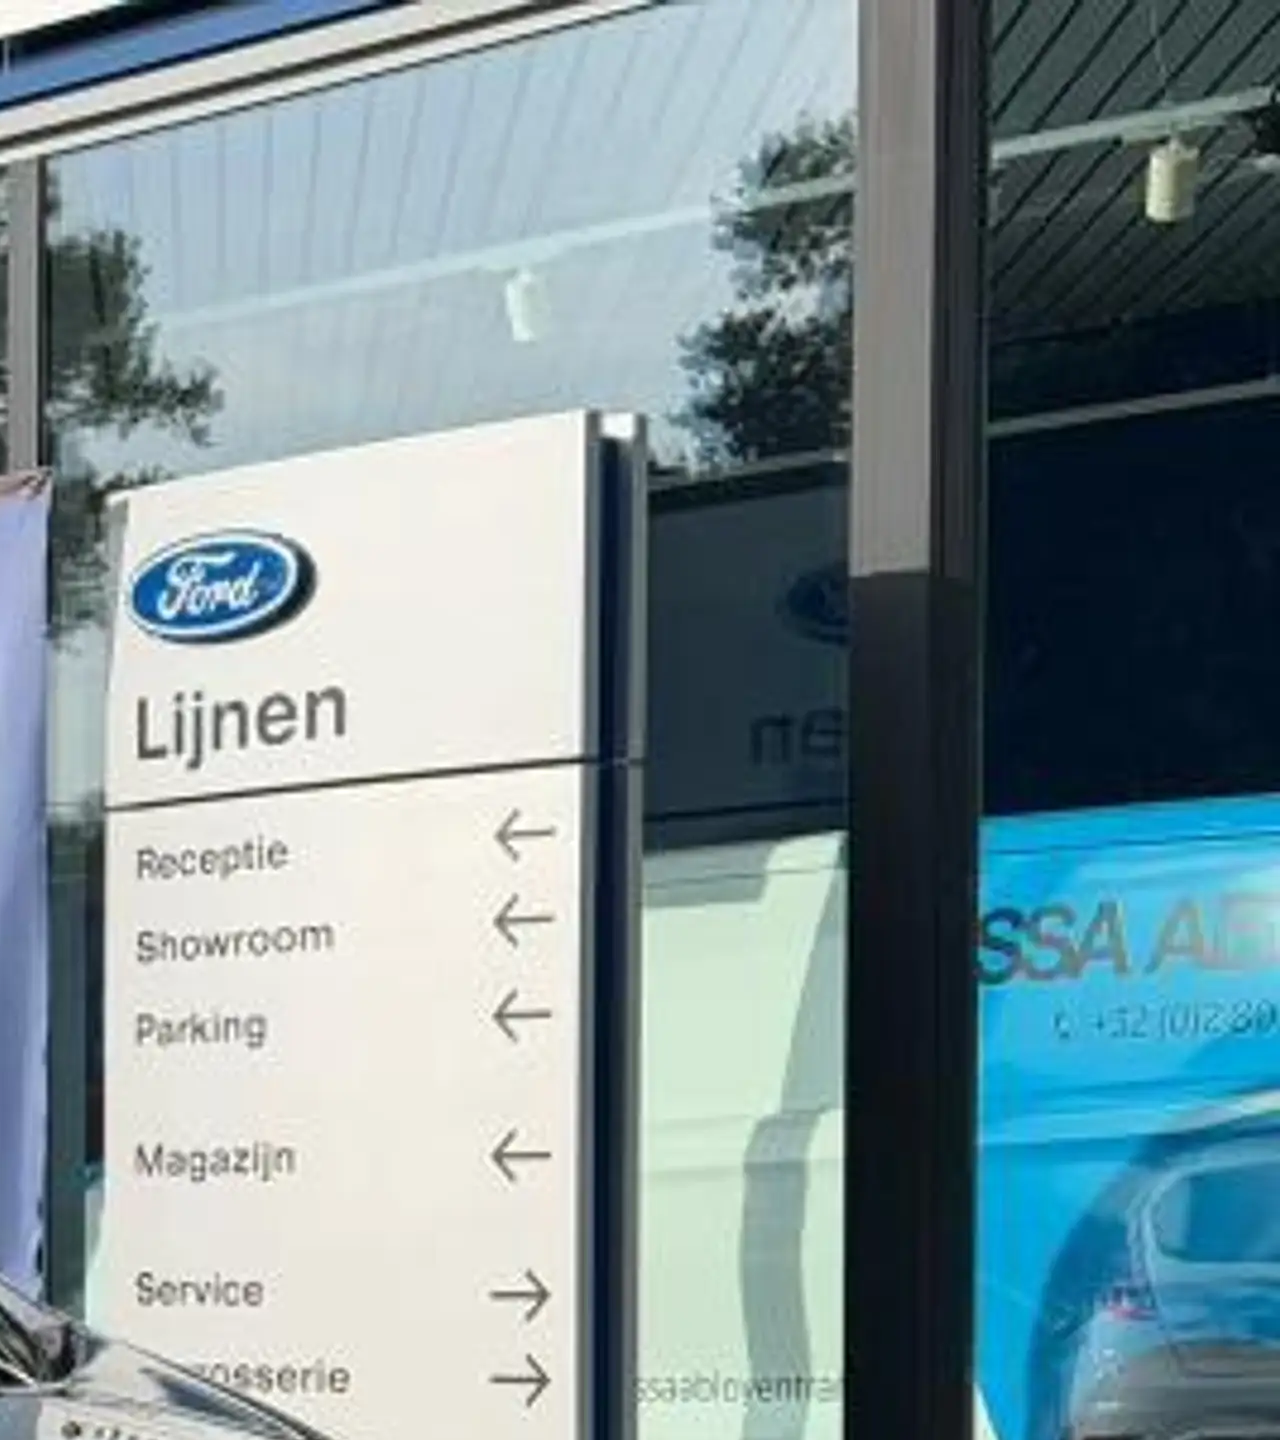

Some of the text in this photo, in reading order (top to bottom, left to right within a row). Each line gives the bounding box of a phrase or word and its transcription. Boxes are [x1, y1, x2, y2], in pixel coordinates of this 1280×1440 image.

[156, 551, 263, 621] Ford
[137, 685, 347, 770] Lijnen
[136, 834, 289, 880] Receptie
[136, 925, 335, 965] Showroom
[136, 1012, 268, 1050] Parking
[134, 1140, 296, 1183] Magazijn
[135, 1271, 264, 1308] Service
